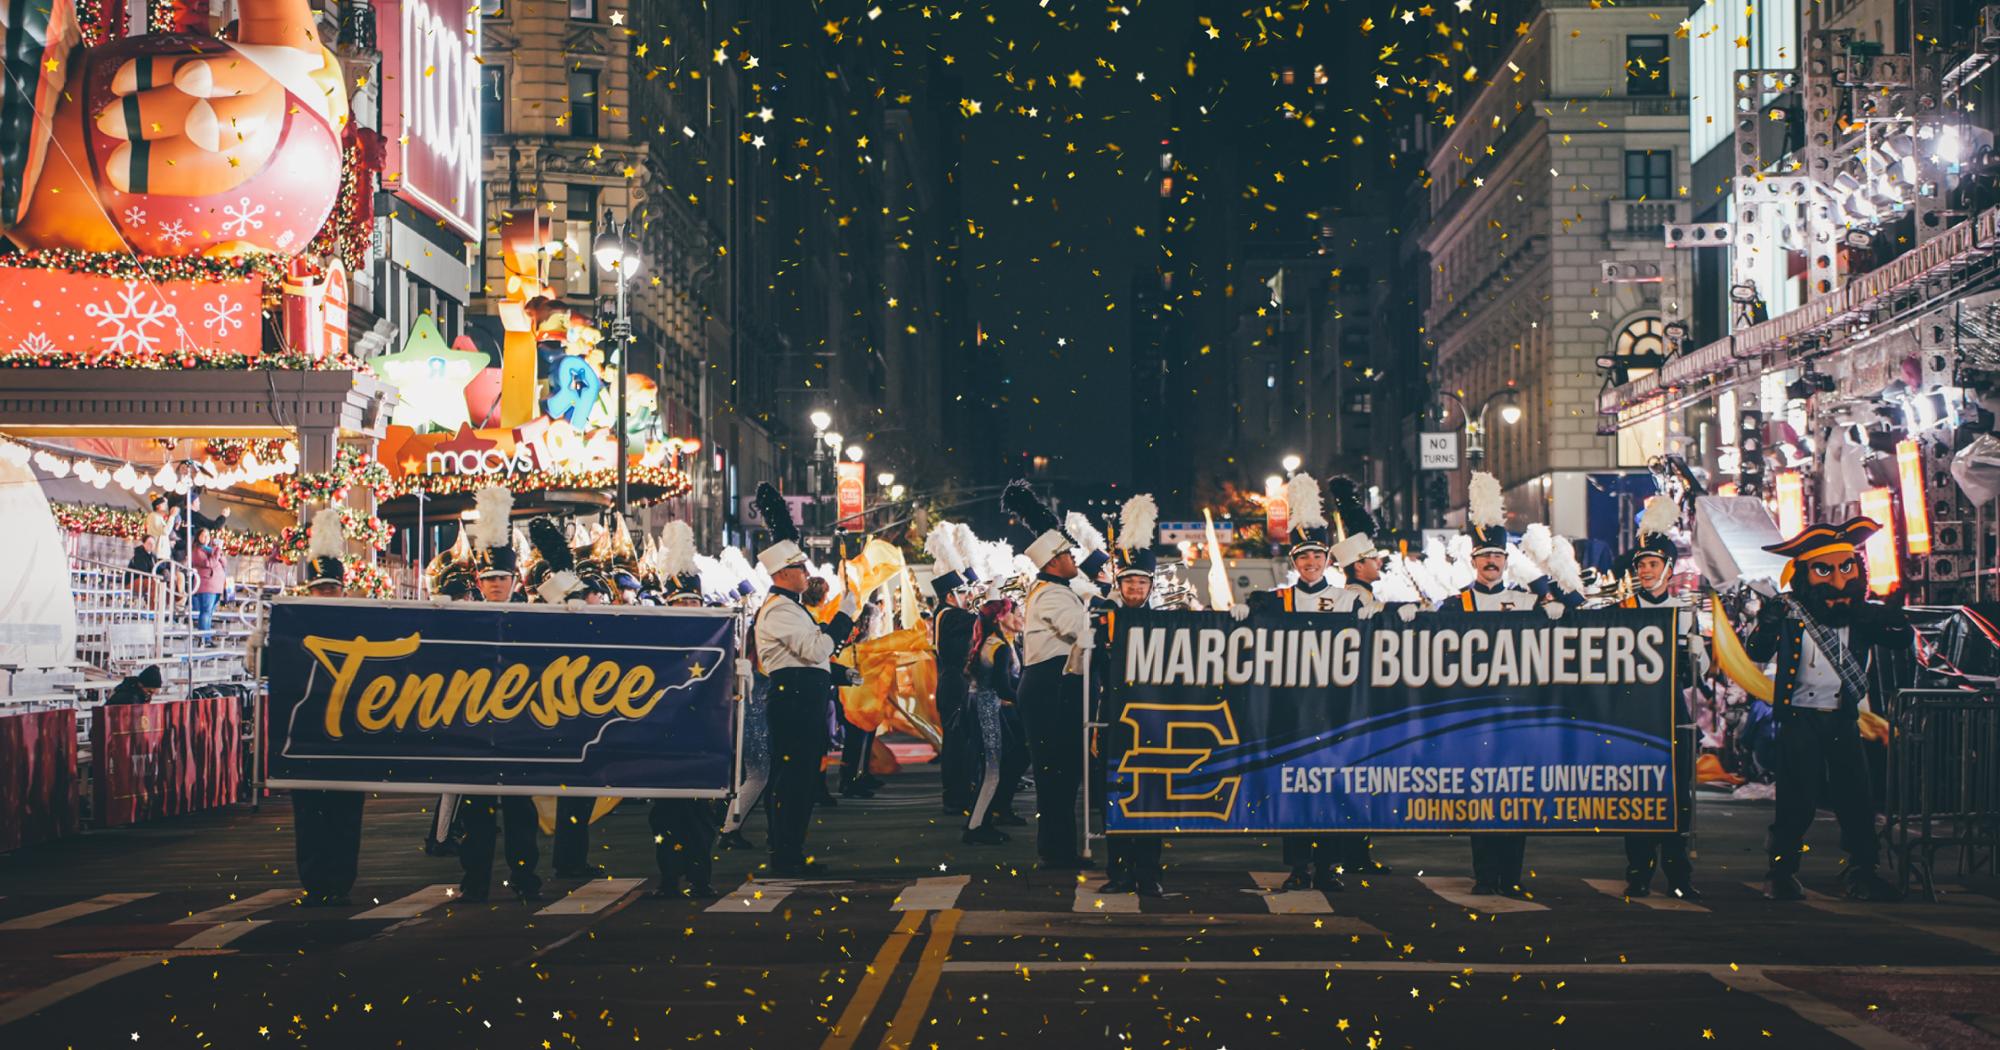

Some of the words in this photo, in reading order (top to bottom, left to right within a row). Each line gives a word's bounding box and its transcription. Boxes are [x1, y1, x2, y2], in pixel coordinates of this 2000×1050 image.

[1430, 438, 1447, 449] NO
[1424, 454, 1455, 463] TURNS
[1125, 626, 1361, 687] MARCHING
[1371, 625, 1664, 687] BUCCANEERS
[304, 632, 663, 739] Tennessee
[1281, 766, 1334, 793] EAST
[1341, 766, 1465, 794] TENNESSEE
[1470, 766, 1534, 793] STATE
[1540, 765, 1667, 792] UNIVERSITY
[1405, 798, 1493, 821] JOHNSON
[1500, 798, 1548, 823] CITY,
[1553, 798, 1667, 821] TENNESSEE
